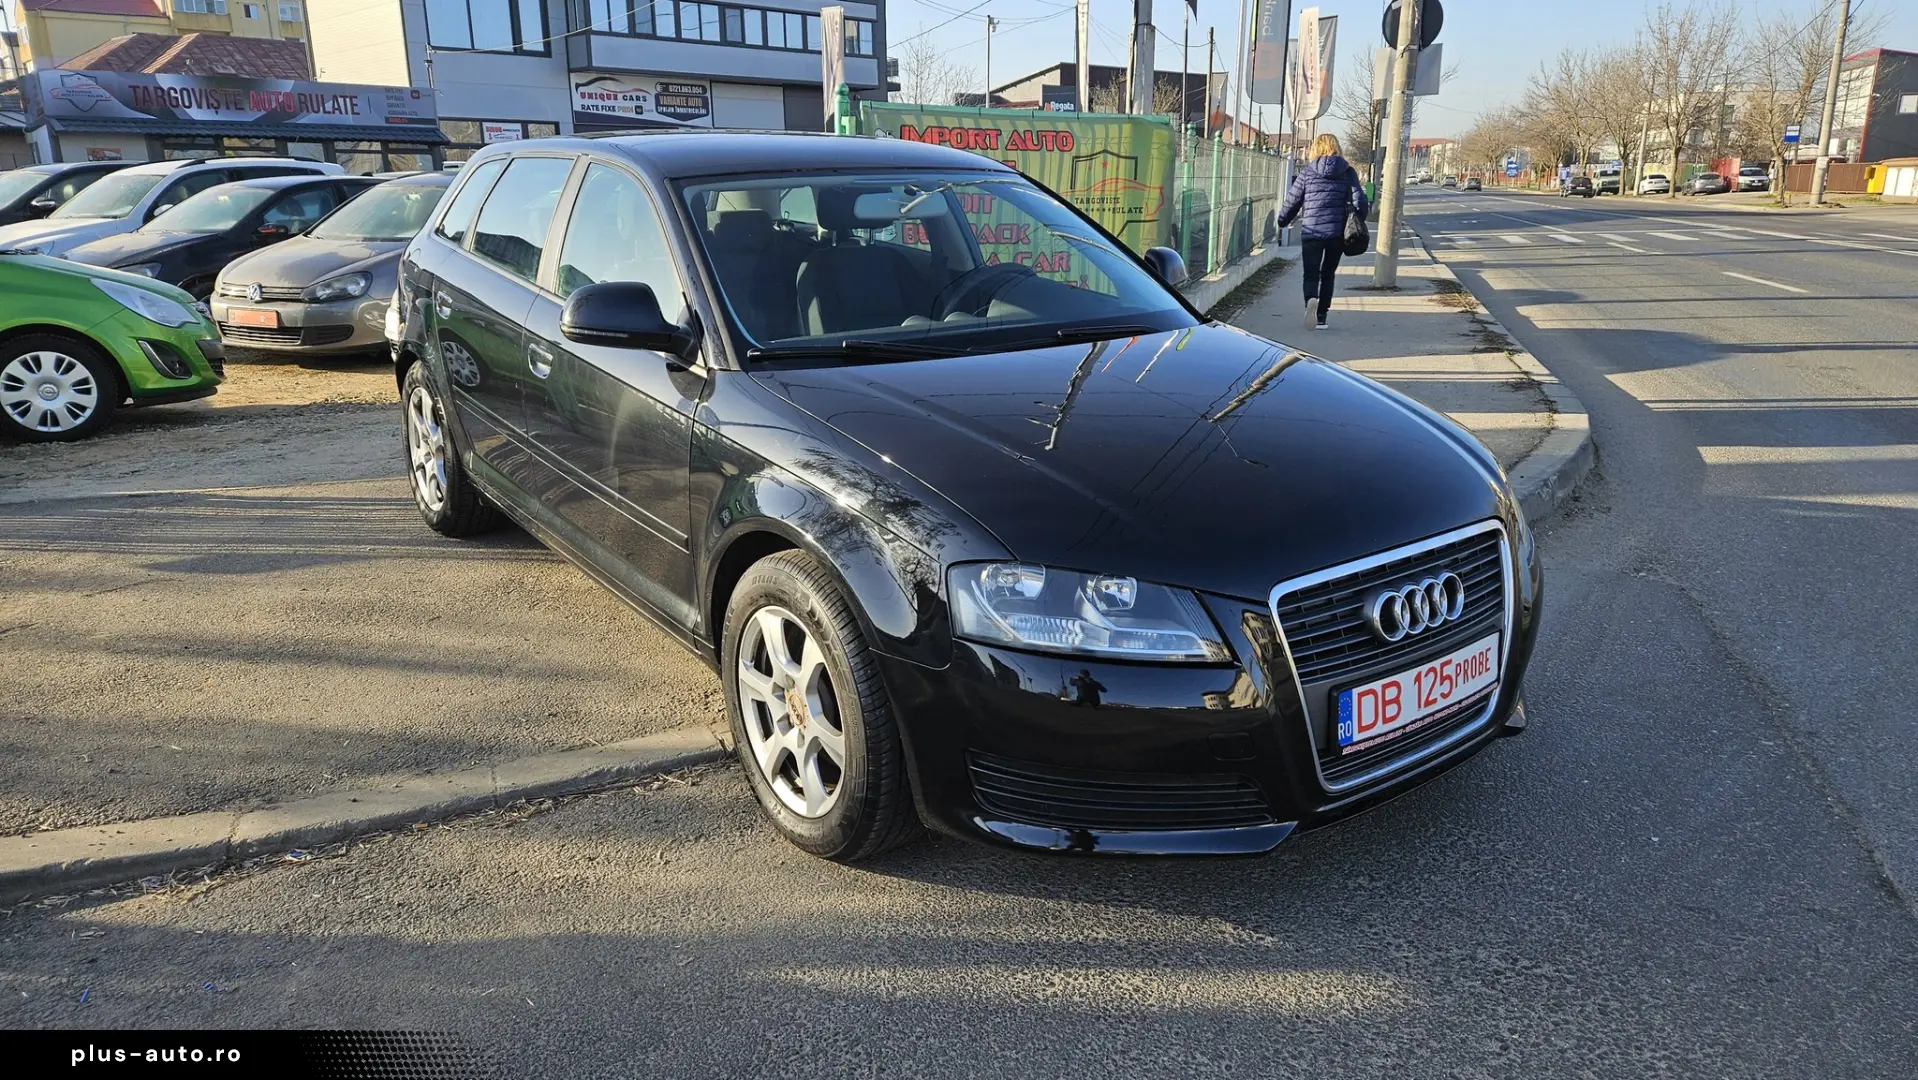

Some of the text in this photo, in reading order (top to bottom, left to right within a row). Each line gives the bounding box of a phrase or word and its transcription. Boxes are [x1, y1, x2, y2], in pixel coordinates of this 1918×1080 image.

[249, 90, 295, 113] AUTO
[299, 92, 360, 116] RULATE
[580, 92, 647, 102] UNIQUE CARS
[659, 95, 703, 107] VARIANTE AUTO
[580, 104, 599, 112] RATE
[601, 104, 616, 113] FIXE
[1050, 101, 1075, 112] Regata
[900, 124, 1075, 152] IMPORT AUTO
[1074, 197, 1121, 205] TARGOVISTE
[1357, 680, 1402, 734] DB
[1414, 658, 1454, 711] 125
[1455, 647, 1491, 689] PROBE
[1338, 720, 1352, 740] RO
